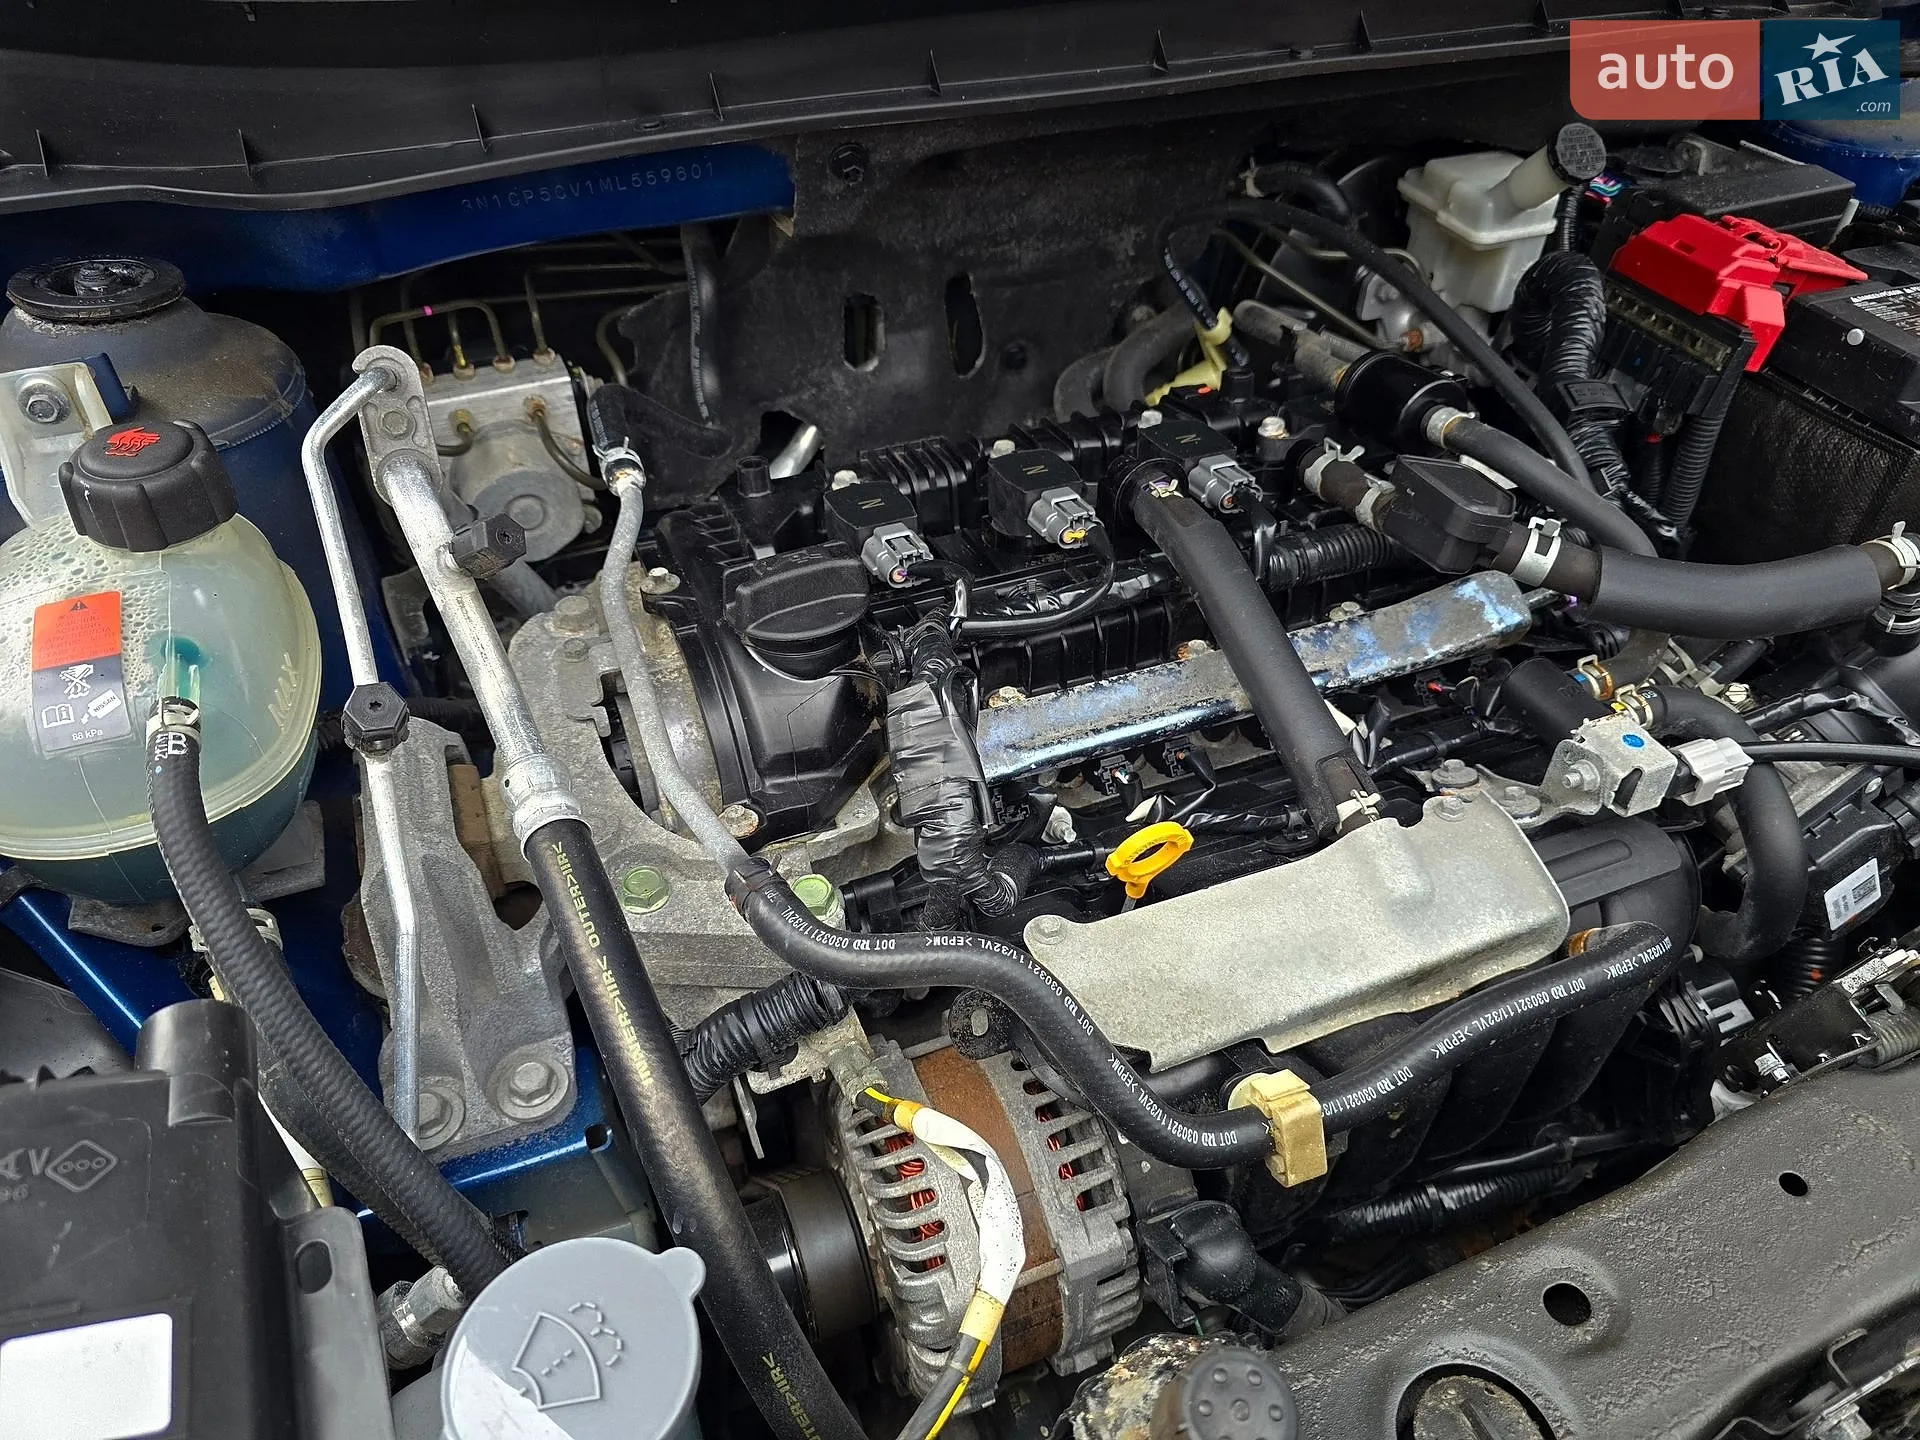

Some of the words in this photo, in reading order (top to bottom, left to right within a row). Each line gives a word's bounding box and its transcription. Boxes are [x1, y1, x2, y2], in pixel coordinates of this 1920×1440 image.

[92, 695, 117, 713] NISSAN
[71, 731, 84, 742] 88
[86, 728, 103, 739] kPa
[810, 928, 849, 949] 030321
[873, 938, 896, 951] DOT
[1027, 959, 1063, 997] 030321
[1568, 977, 1587, 995] DOT
[1515, 991, 1550, 1013] 030321
[1077, 1015, 1095, 1037] DOT
[1392, 1065, 1414, 1086] DOT
[1344, 1086, 1377, 1109] 030321
[1167, 1120, 1198, 1145] 030321
[1219, 1130, 1238, 1146] DOT
